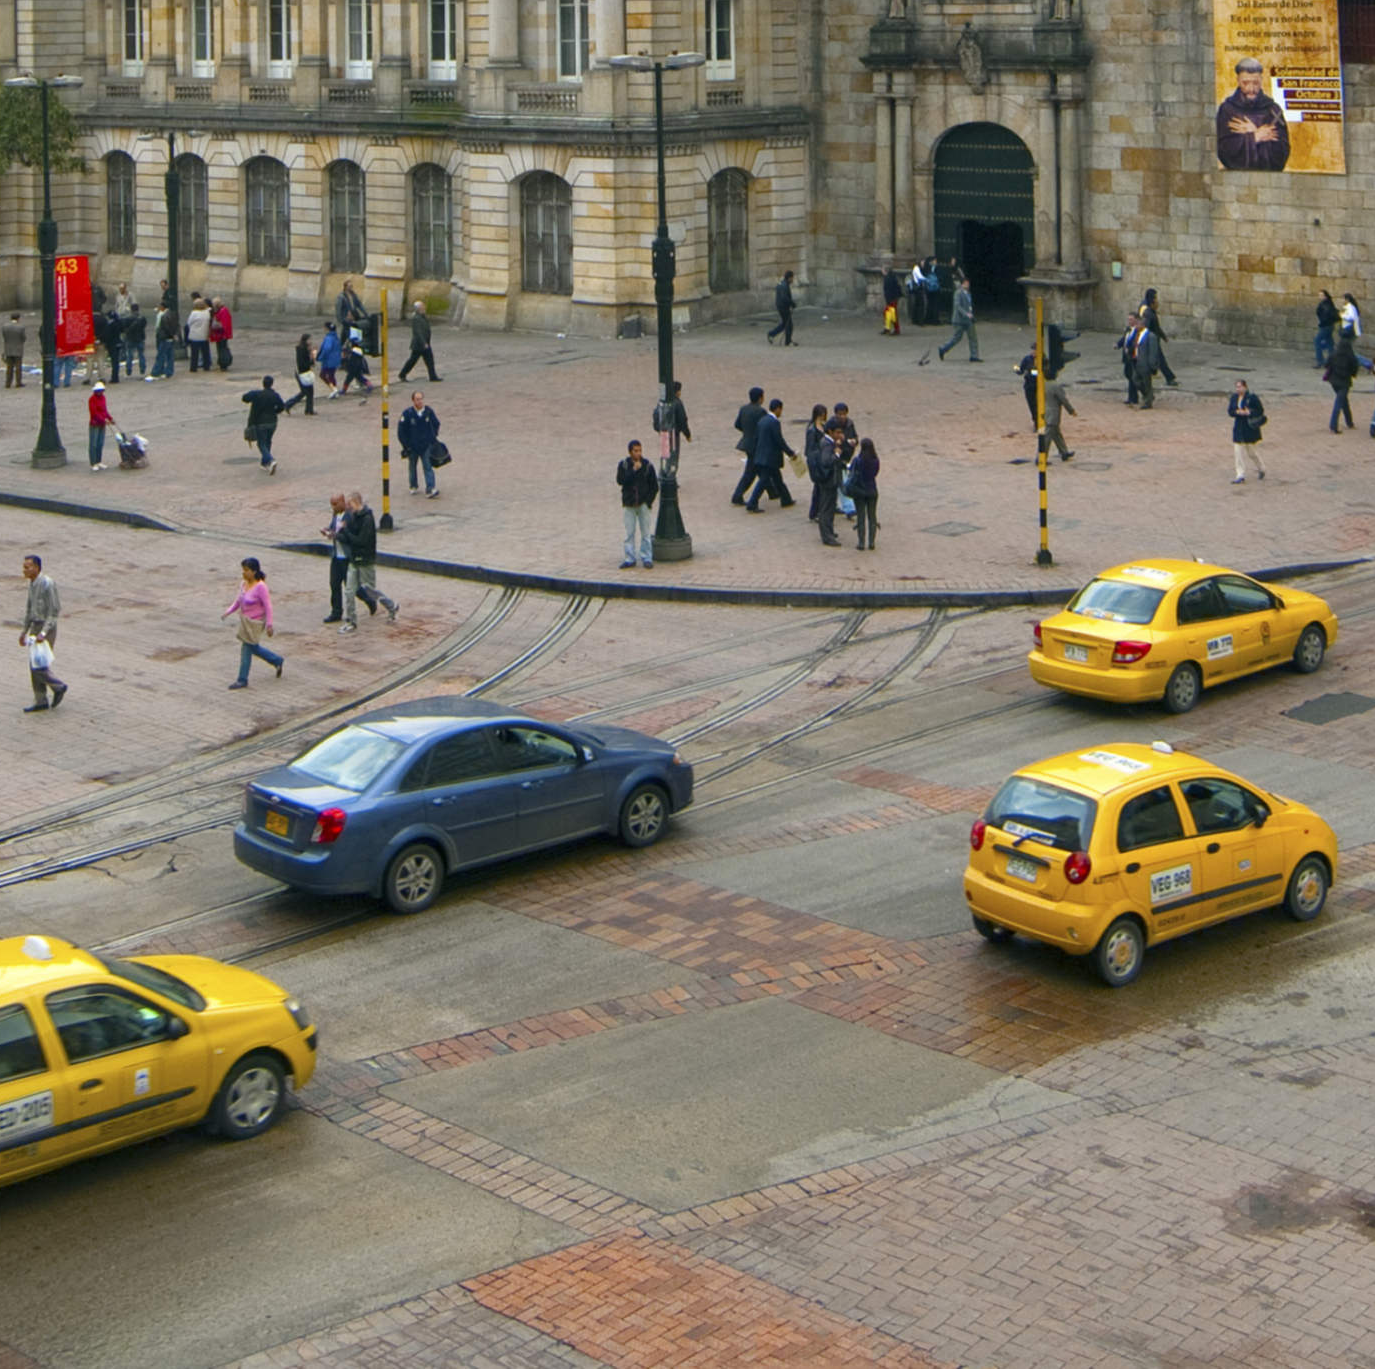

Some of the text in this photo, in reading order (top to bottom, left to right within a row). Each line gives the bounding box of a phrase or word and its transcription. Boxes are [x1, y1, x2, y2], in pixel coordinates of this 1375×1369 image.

[1236, 0, 1314, 9] Del Reino de Dios
[1230, 14, 1323, 25] En el que ya no deben
[1236, 29, 1316, 38] existir muros entre
[1264, 44, 1274, 52] ni
[1274, 67, 1339, 77] Solemnidad de
[1281, 79, 1340, 89] San Francisco
[1295, 89, 1332, 99] Octubre
[56, 258, 79, 274] 43
[1151, 874, 1172, 894] VEG
[1173, 869, 1192, 888] 968
